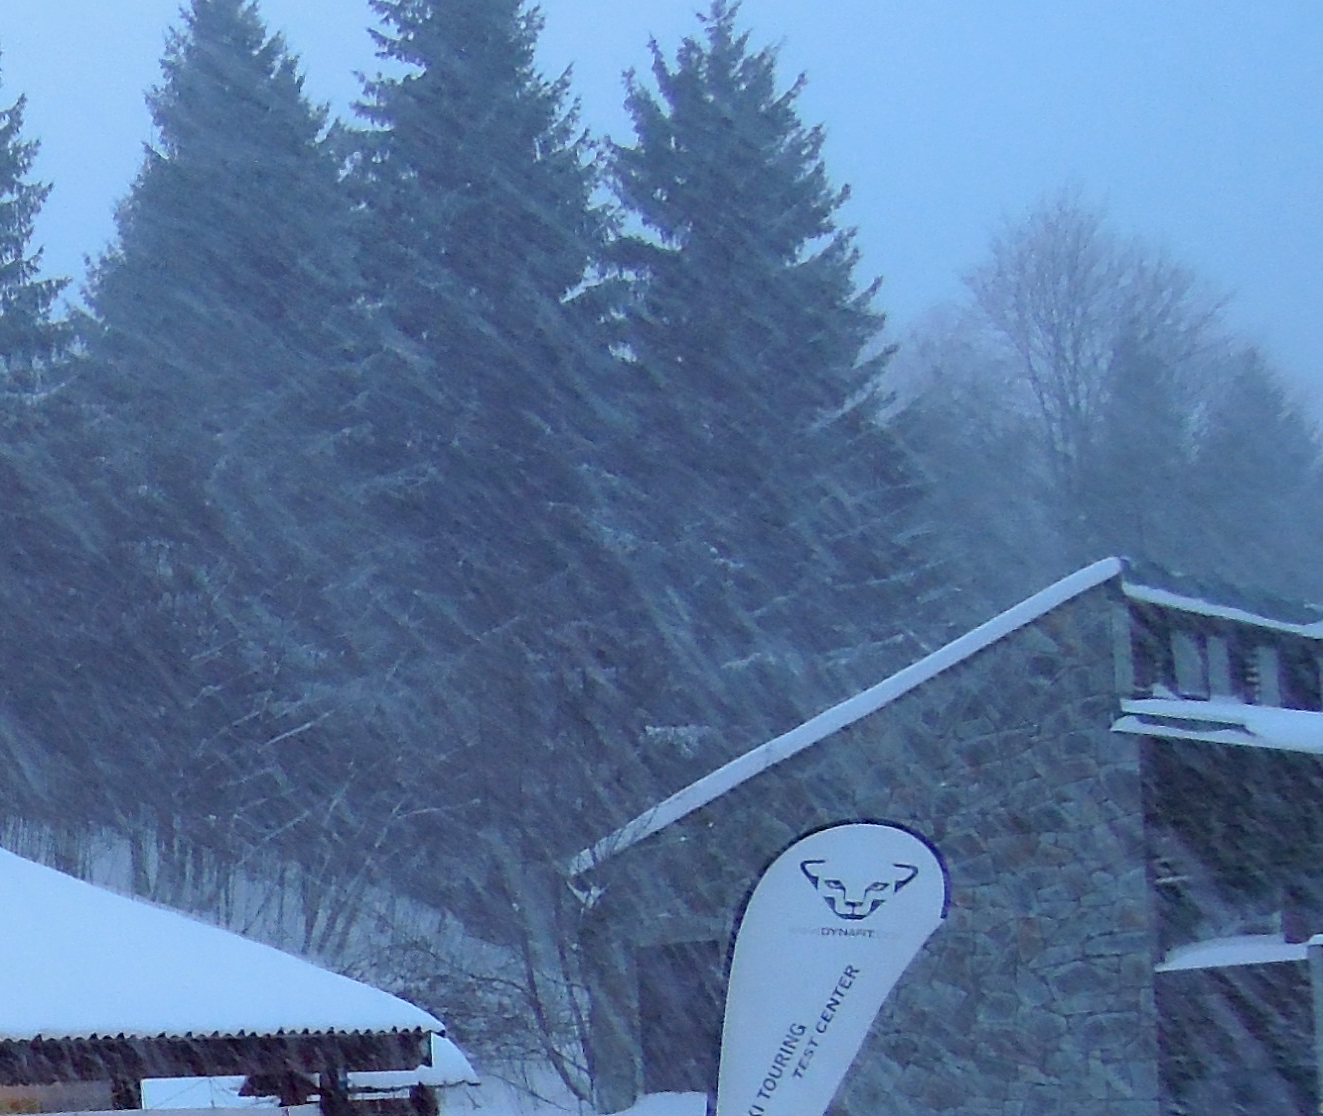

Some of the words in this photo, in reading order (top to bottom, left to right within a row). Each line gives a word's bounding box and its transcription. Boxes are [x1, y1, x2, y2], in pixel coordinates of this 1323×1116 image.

[756, 1022, 807, 1101] TOURING
[792, 1037, 819, 1080] TEST
[815, 964, 861, 1034] CENTER
